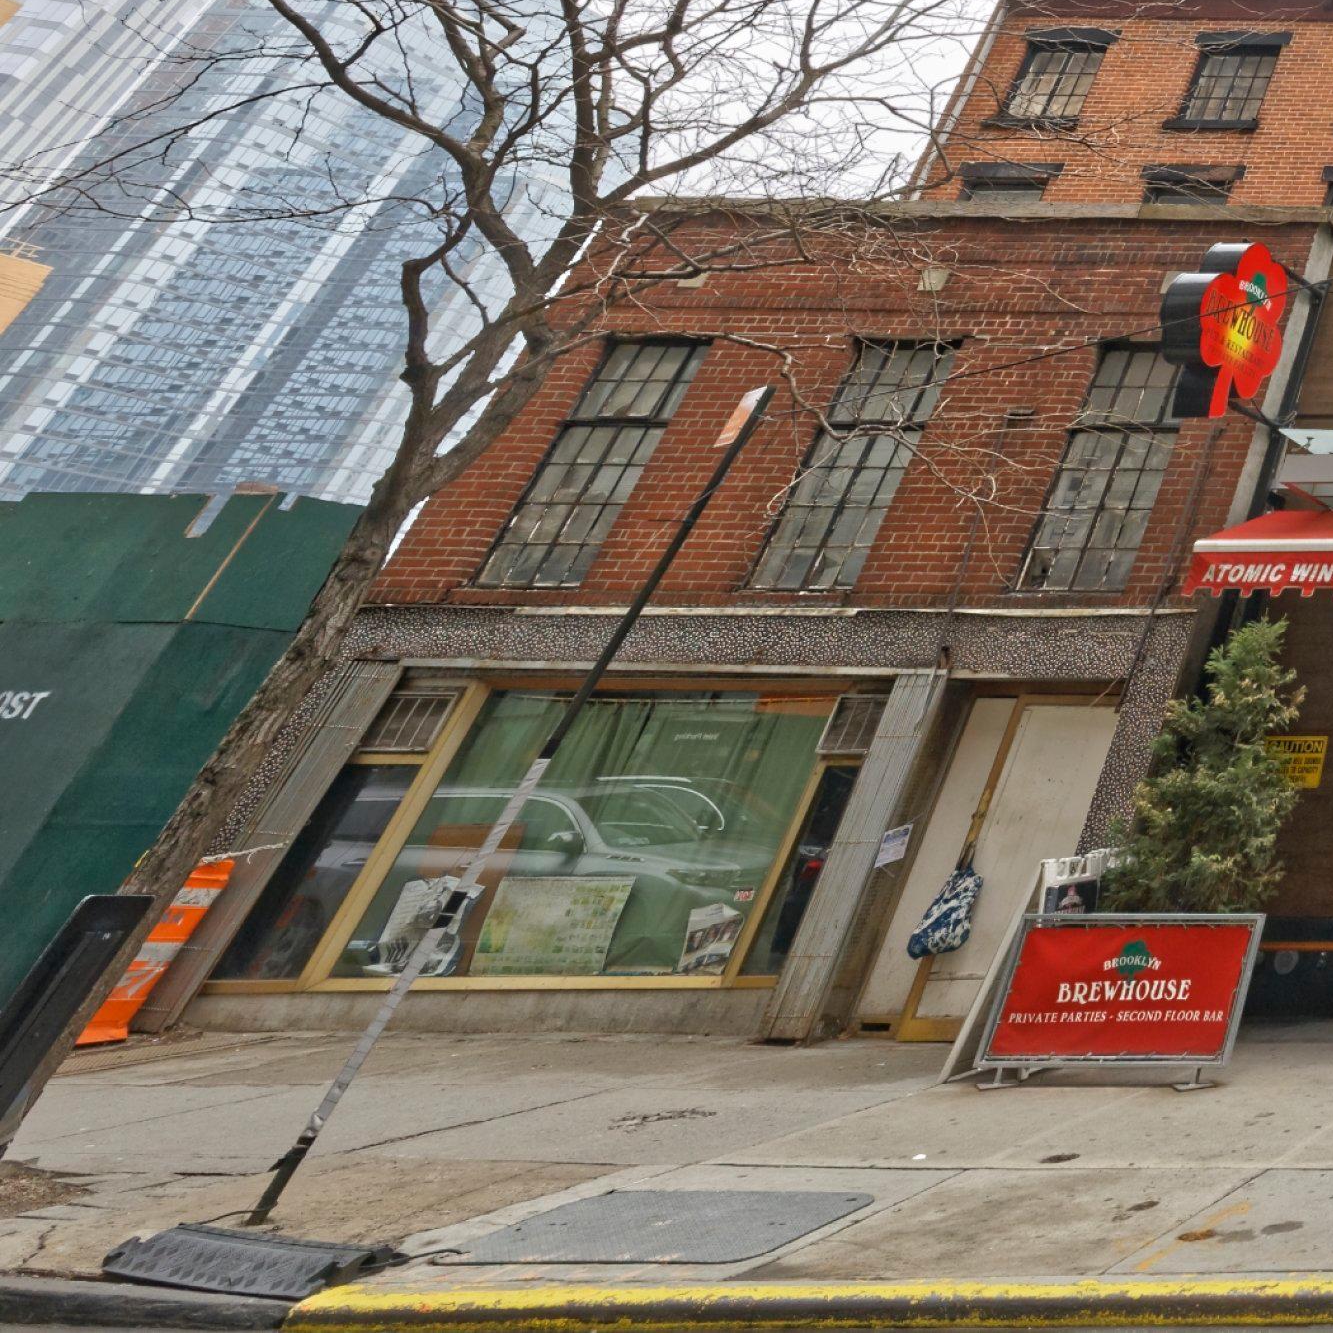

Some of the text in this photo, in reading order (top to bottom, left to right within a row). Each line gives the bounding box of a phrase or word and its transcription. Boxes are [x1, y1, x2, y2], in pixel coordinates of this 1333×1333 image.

[1238, 280, 1273, 311] BROOKLYN
[1202, 563, 1286, 583] ATOMIC
[1103, 954, 1162, 972] BROOKLYN
[1056, 979, 1192, 1005] BREWHOUSE
[1008, 1011, 1058, 1024] PRIVATE
[1060, 1010, 1107, 1023] PARTIES
[1116, 1010, 1162, 1022] SECOND
[1165, 1010, 1201, 1022] FLOOR
[1203, 1010, 1224, 1022] BAR
